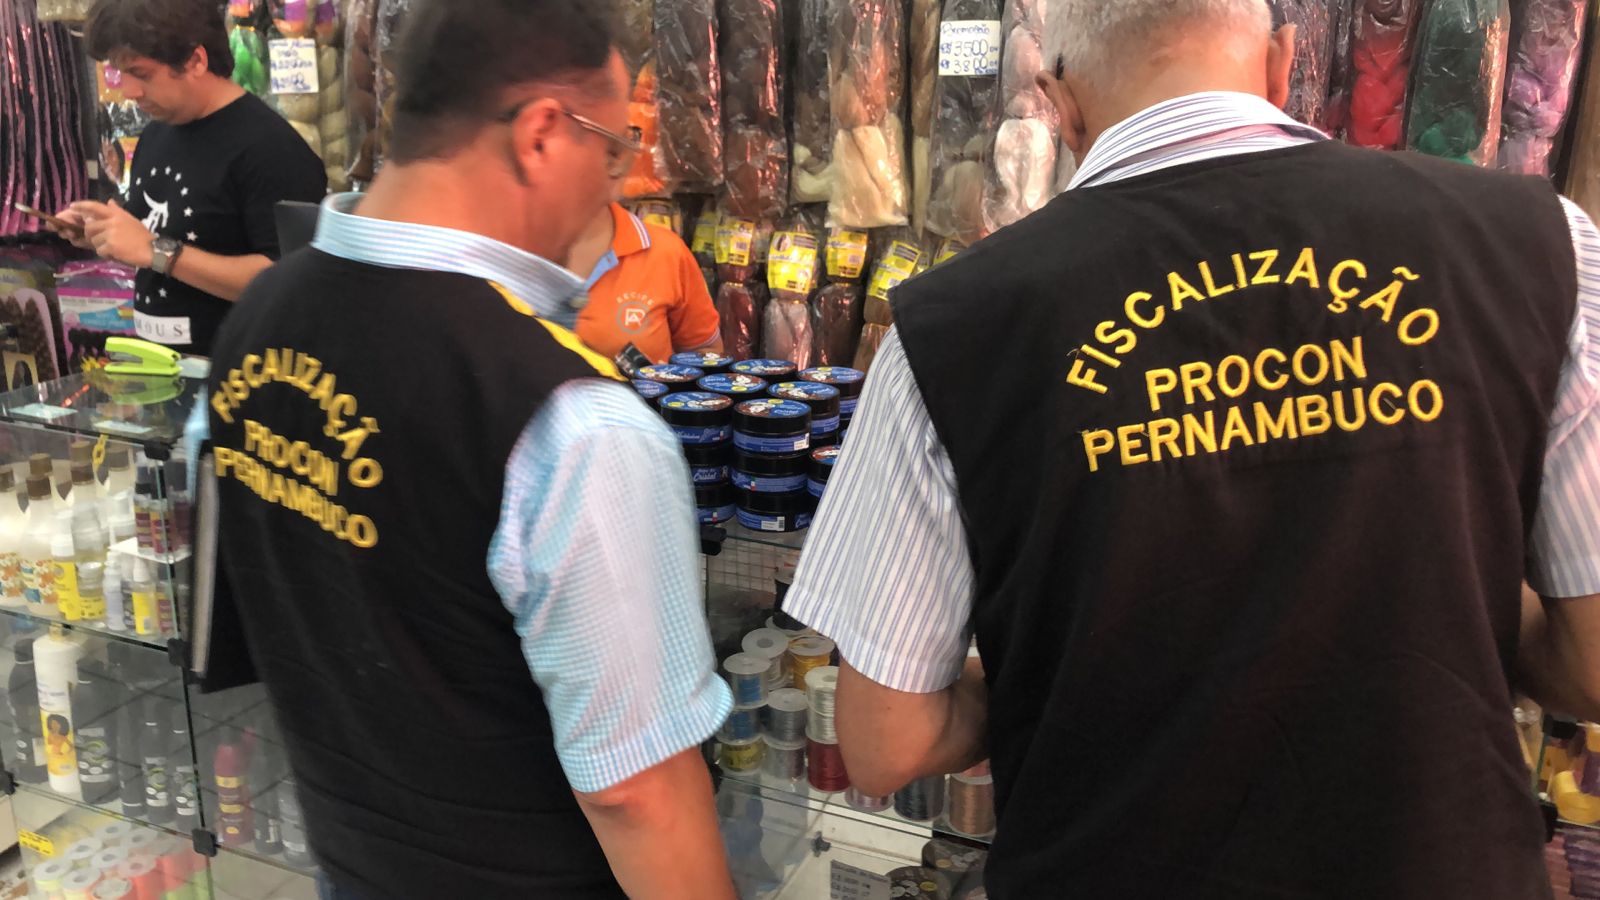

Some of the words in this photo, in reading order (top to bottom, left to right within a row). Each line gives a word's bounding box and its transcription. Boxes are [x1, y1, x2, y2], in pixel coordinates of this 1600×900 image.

[1066, 247, 1441, 396] FISCALIZAÇÃO
[211, 348, 383, 488] FISCALIZAÇÃO
[1145, 336, 1368, 412] PROCON
[244, 419, 340, 496] PROCON
[1081, 379, 1445, 473] PERNAMBUCO
[213, 446, 379, 548] PERNAMBUCO
